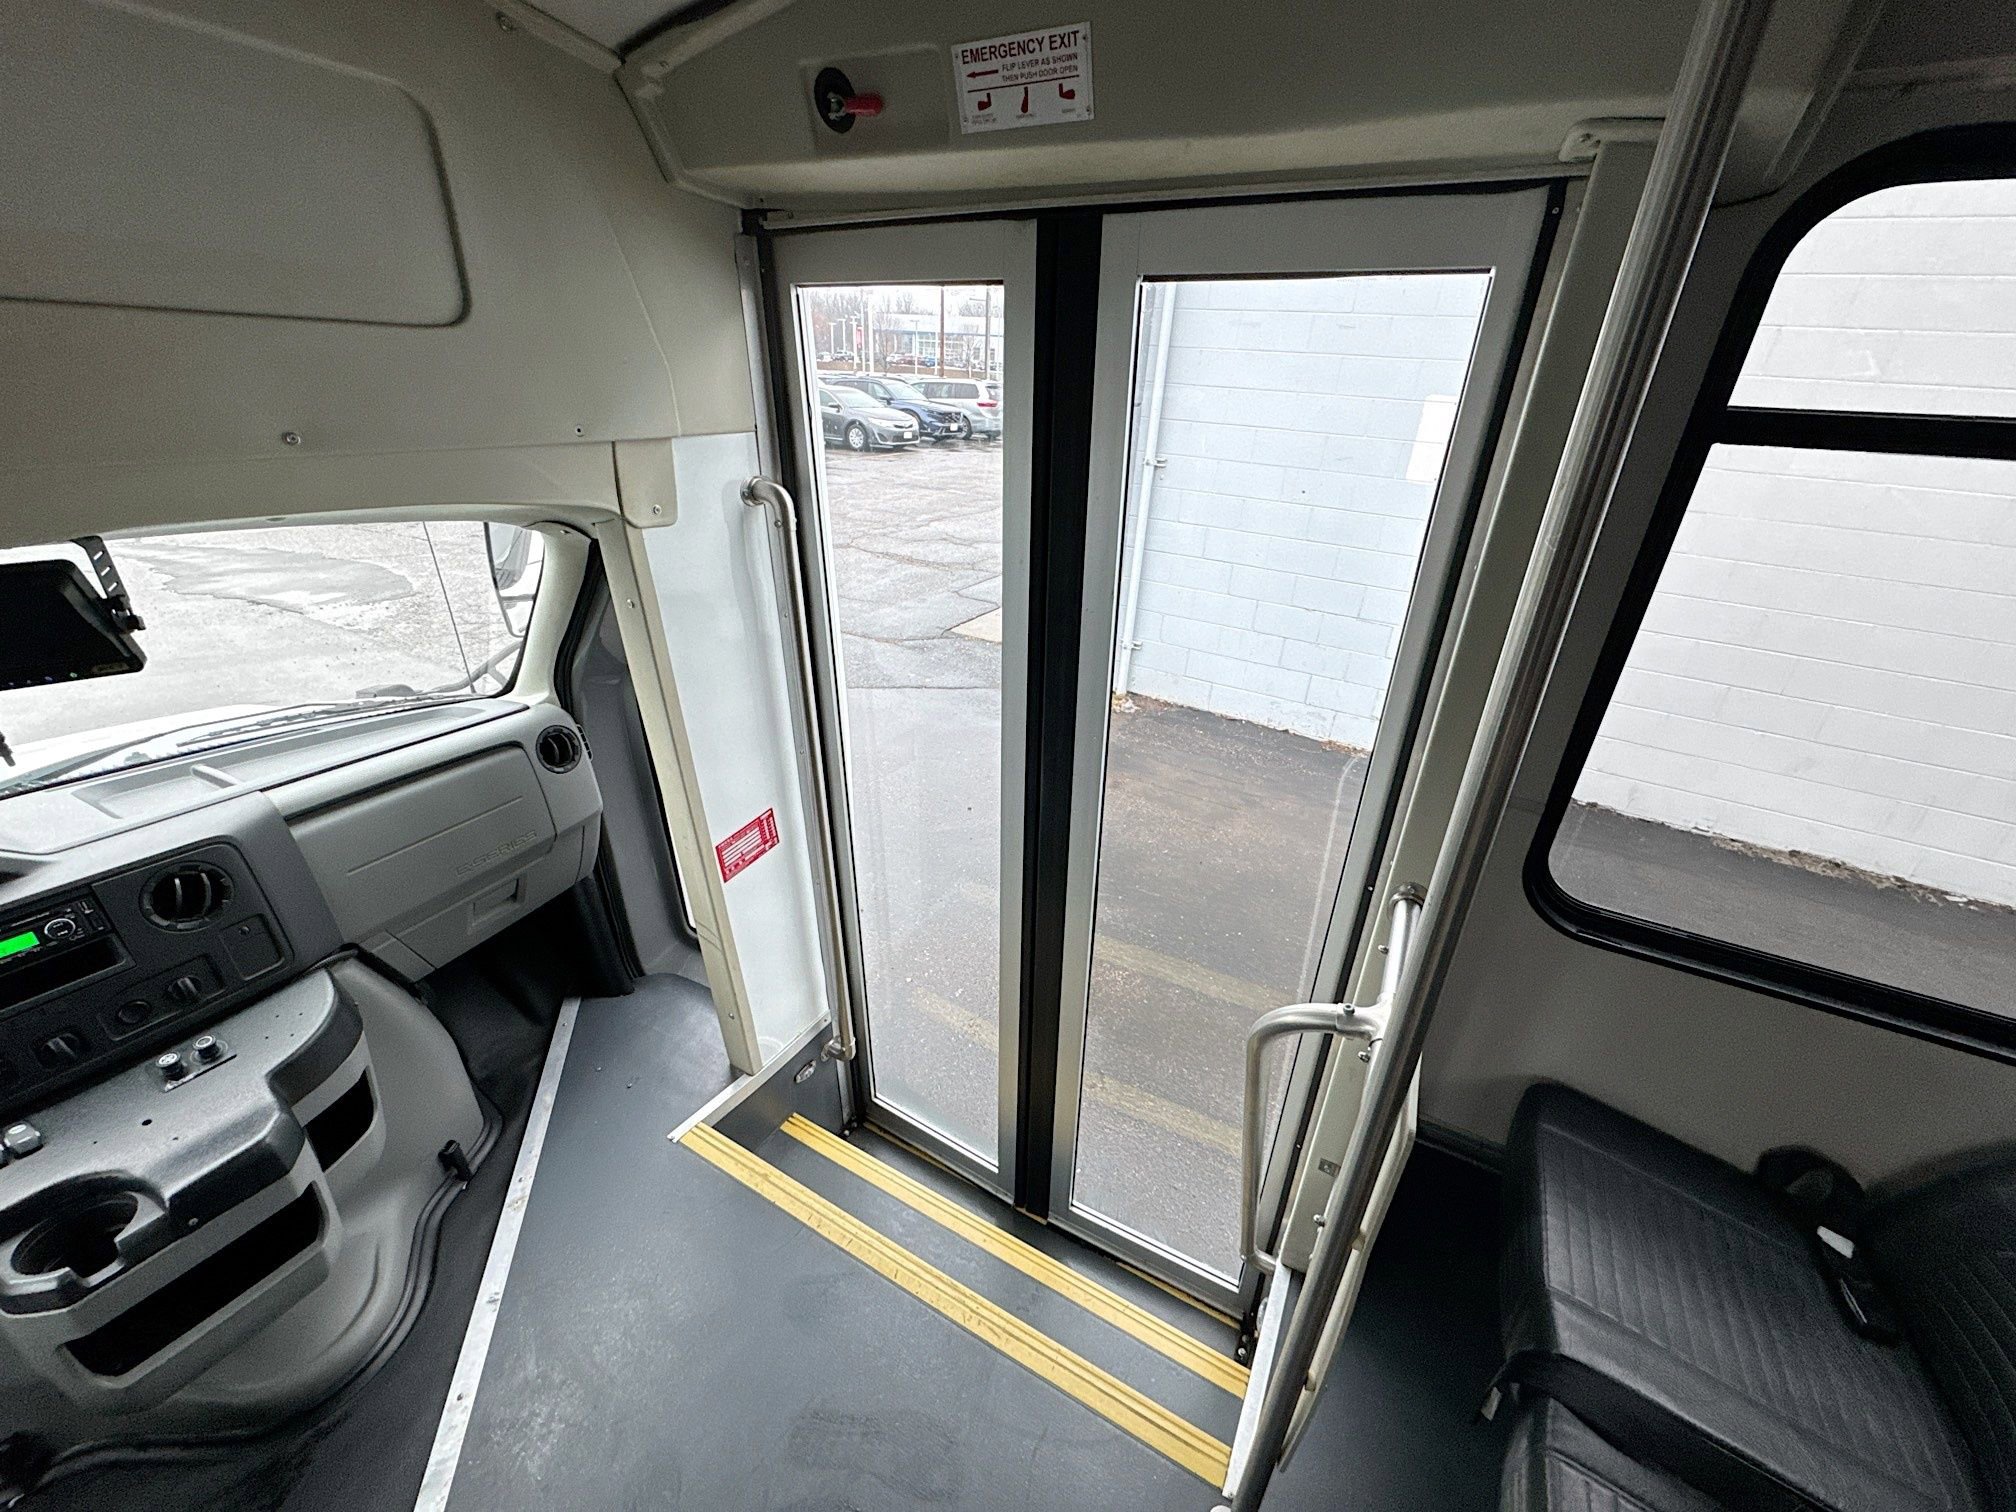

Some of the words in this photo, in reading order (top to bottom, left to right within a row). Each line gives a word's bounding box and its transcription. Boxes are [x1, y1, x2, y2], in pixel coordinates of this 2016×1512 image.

[961, 36, 1045, 65] EMERGENCY
[1048, 30, 1079, 51] EXIT
[1002, 62, 1016, 72] FLIP
[1018, 59, 1040, 70] LEVER
[1041, 57, 1050, 66] AS
[1052, 52, 1078, 65] SHOWN
[1002, 73, 1019, 82] THEN
[1020, 71, 1038, 80] PUSH
[1039, 68, 1058, 77] DOOR
[1059, 64, 1078, 74] OPEN
